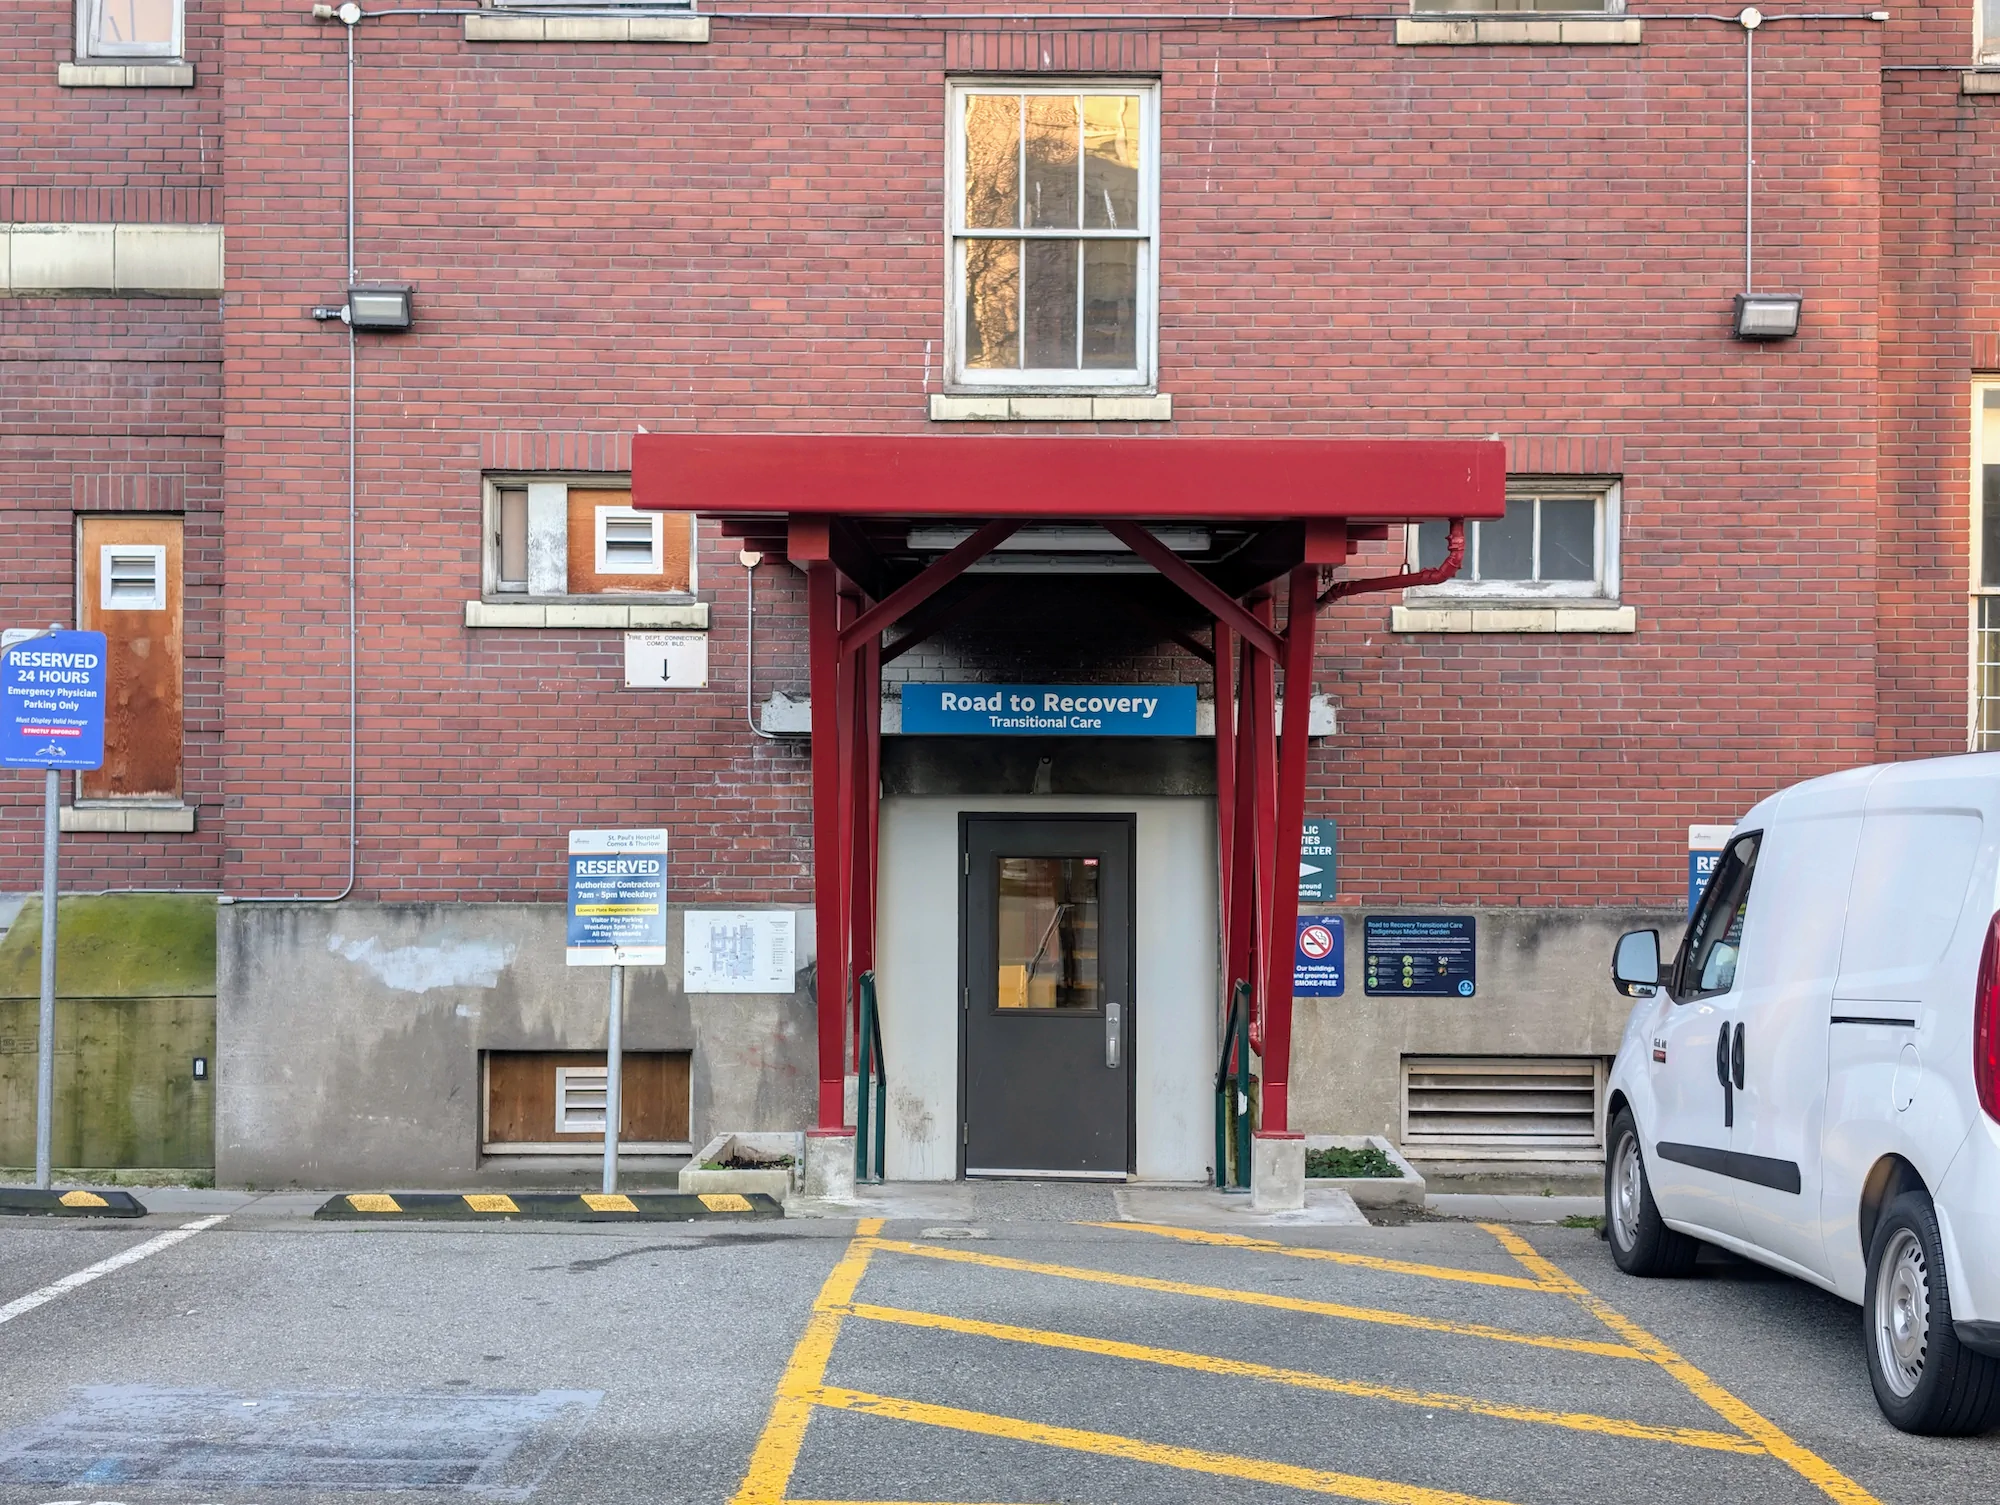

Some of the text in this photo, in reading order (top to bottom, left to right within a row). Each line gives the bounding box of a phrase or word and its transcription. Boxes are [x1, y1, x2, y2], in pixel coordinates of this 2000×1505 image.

[10, 651, 98, 668] RESERVED
[18, 670, 90, 684] 24 HOURS
[8, 686, 98, 698] Emergency Physician
[24, 700, 80, 712] Parking Only
[941, 692, 1158, 718] Road to Recovery
[30, 717, 52, 725] Display
[988, 715, 1102, 729] Transitional Care
[1303, 826, 1318, 834] LIC
[1301, 836, 1320, 844] TIES
[1301, 846, 1332, 855] ELTER
[576, 860, 660, 874] RESERVED
[1697, 856, 1720, 870] RE
[619, 891, 657, 899] Weekdays
